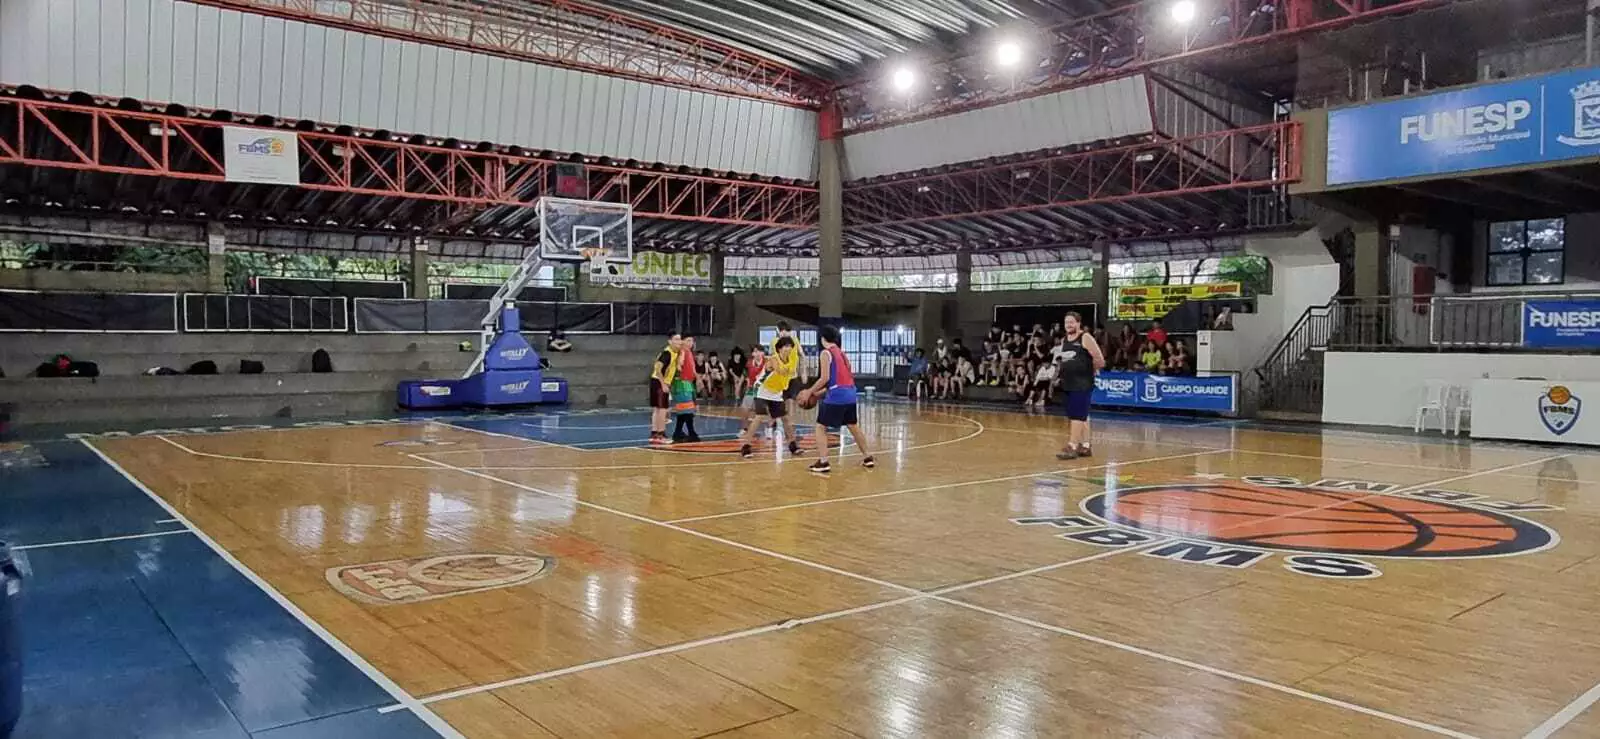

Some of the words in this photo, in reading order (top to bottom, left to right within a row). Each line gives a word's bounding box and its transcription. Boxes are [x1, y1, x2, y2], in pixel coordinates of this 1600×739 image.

[1401, 100, 1531, 144] FUNESP
[1161, 384, 1191, 393] CAMPO
[1193, 387, 1228, 395] GRANDE
[1544, 405, 1574, 415] FBMS
[1009, 516, 1384, 579] FBMS
